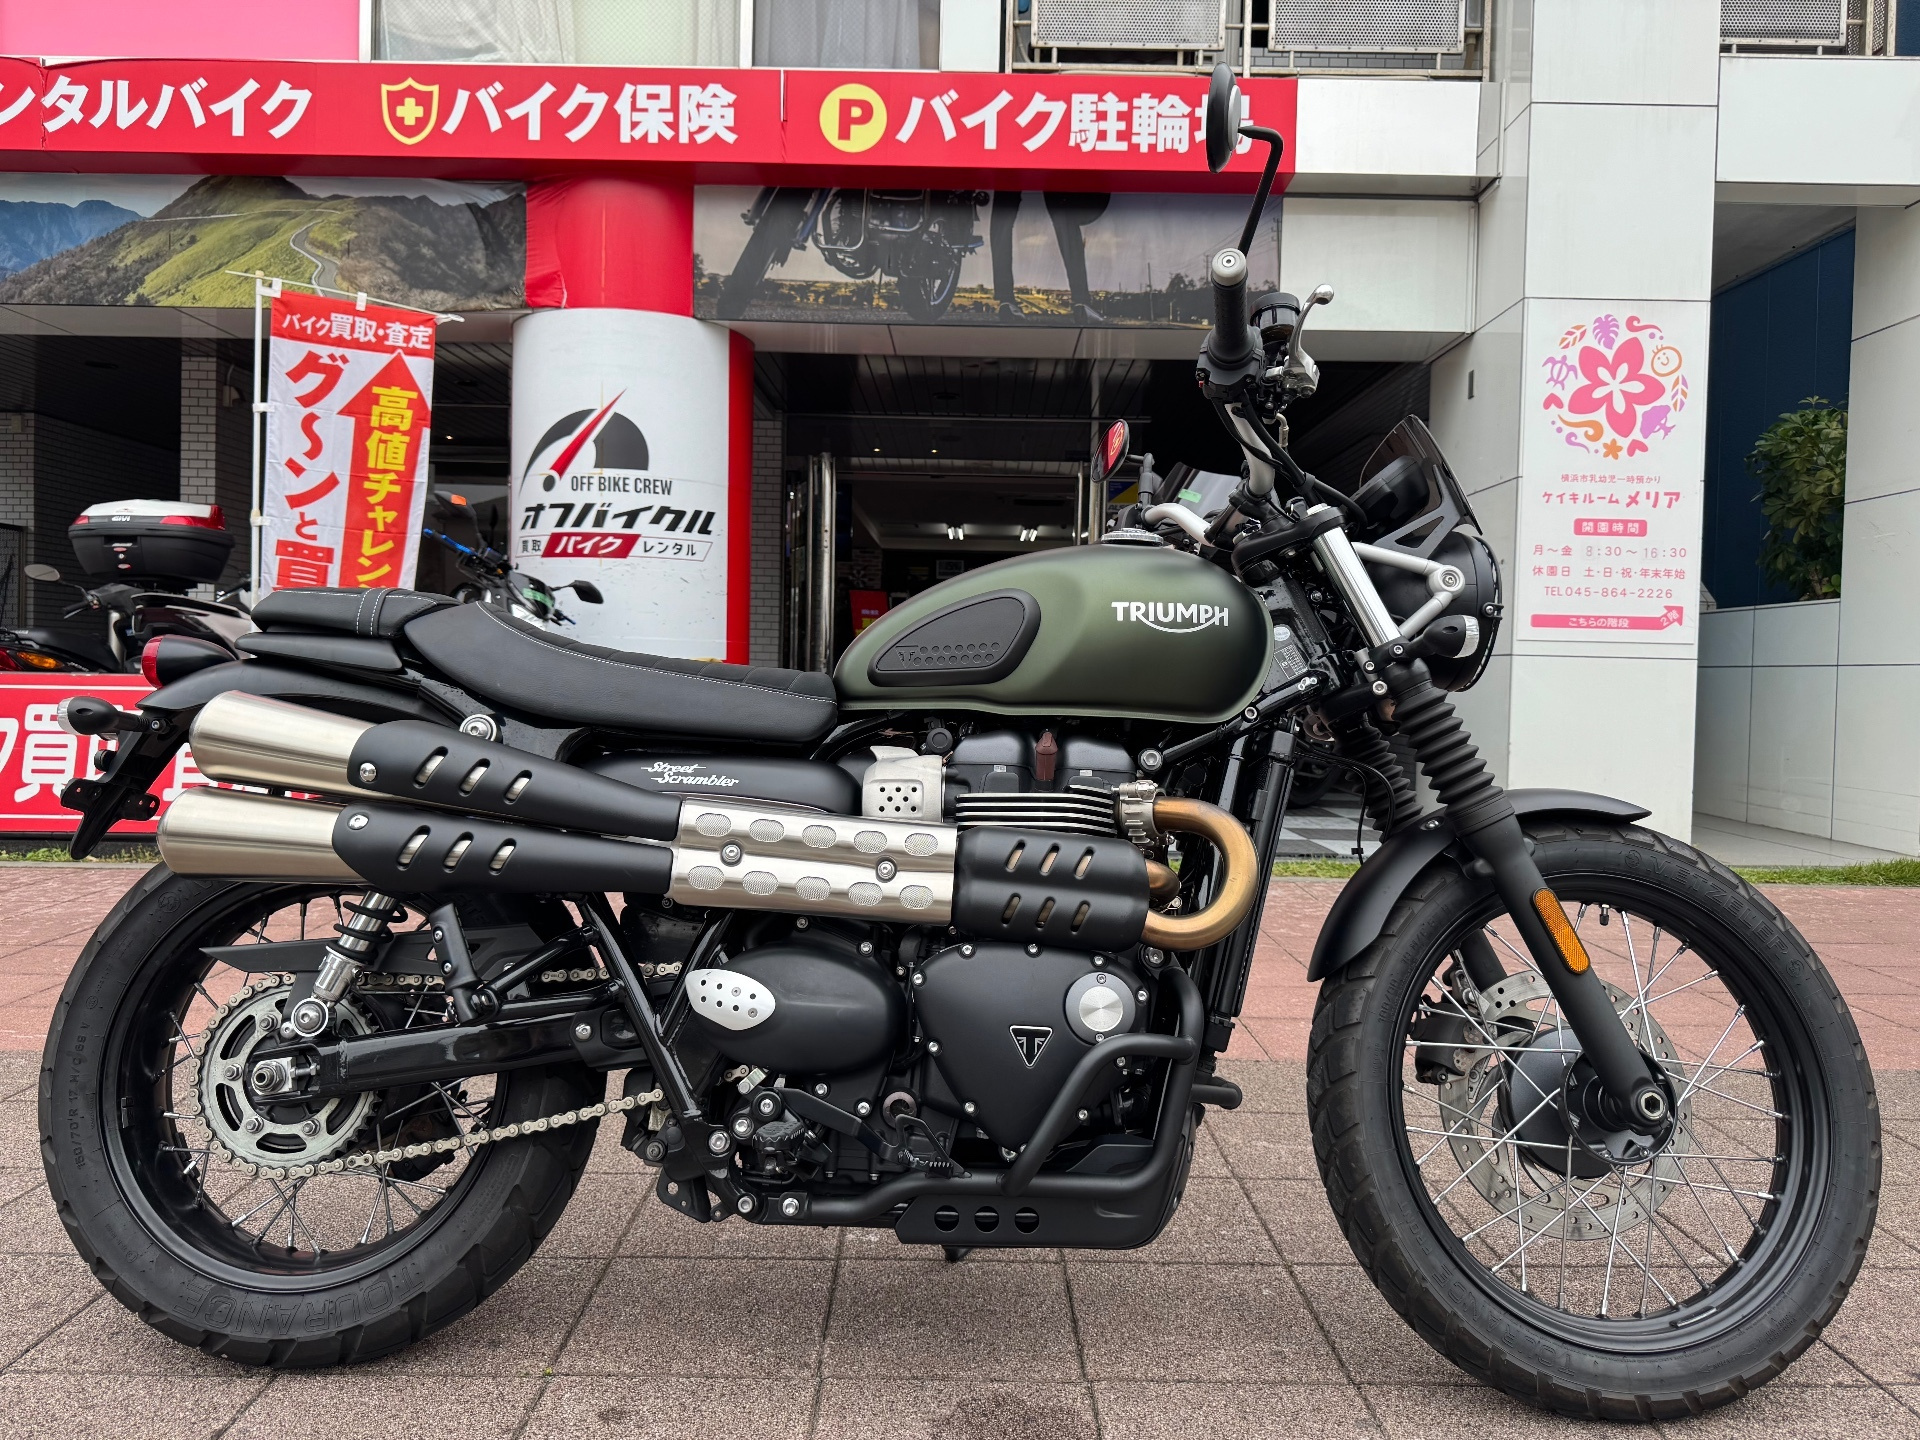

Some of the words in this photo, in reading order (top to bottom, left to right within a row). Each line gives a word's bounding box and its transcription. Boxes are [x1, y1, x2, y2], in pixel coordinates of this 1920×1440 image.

[441, 81, 738, 145] バイク保険
[281, 312, 433, 351] バイク買取・査定
[356, 385, 418, 588] 高値チャレン
[570, 475, 594, 491] OFF
[598, 475, 630, 492] BIKE
[634, 477, 672, 495] CREW
[1561, 474, 1661, 484] 横浜市乳幼児一時預かり
[520, 502, 716, 535] オフバイクル
[1581, 521, 1639, 534] 開園時間
[521, 538, 541, 553] 買取
[554, 535, 623, 554] バイク
[643, 541, 697, 556] レンタル
[1532, 565, 1571, 577] 休園日
[1111, 601, 1229, 633] TRIUMPH
[1568, 617, 1630, 628] こちらの階段
[641, 762, 707, 773] Street
[651, 771, 739, 787] Scrambler
[171, 1265, 425, 1336] TOURANCE
